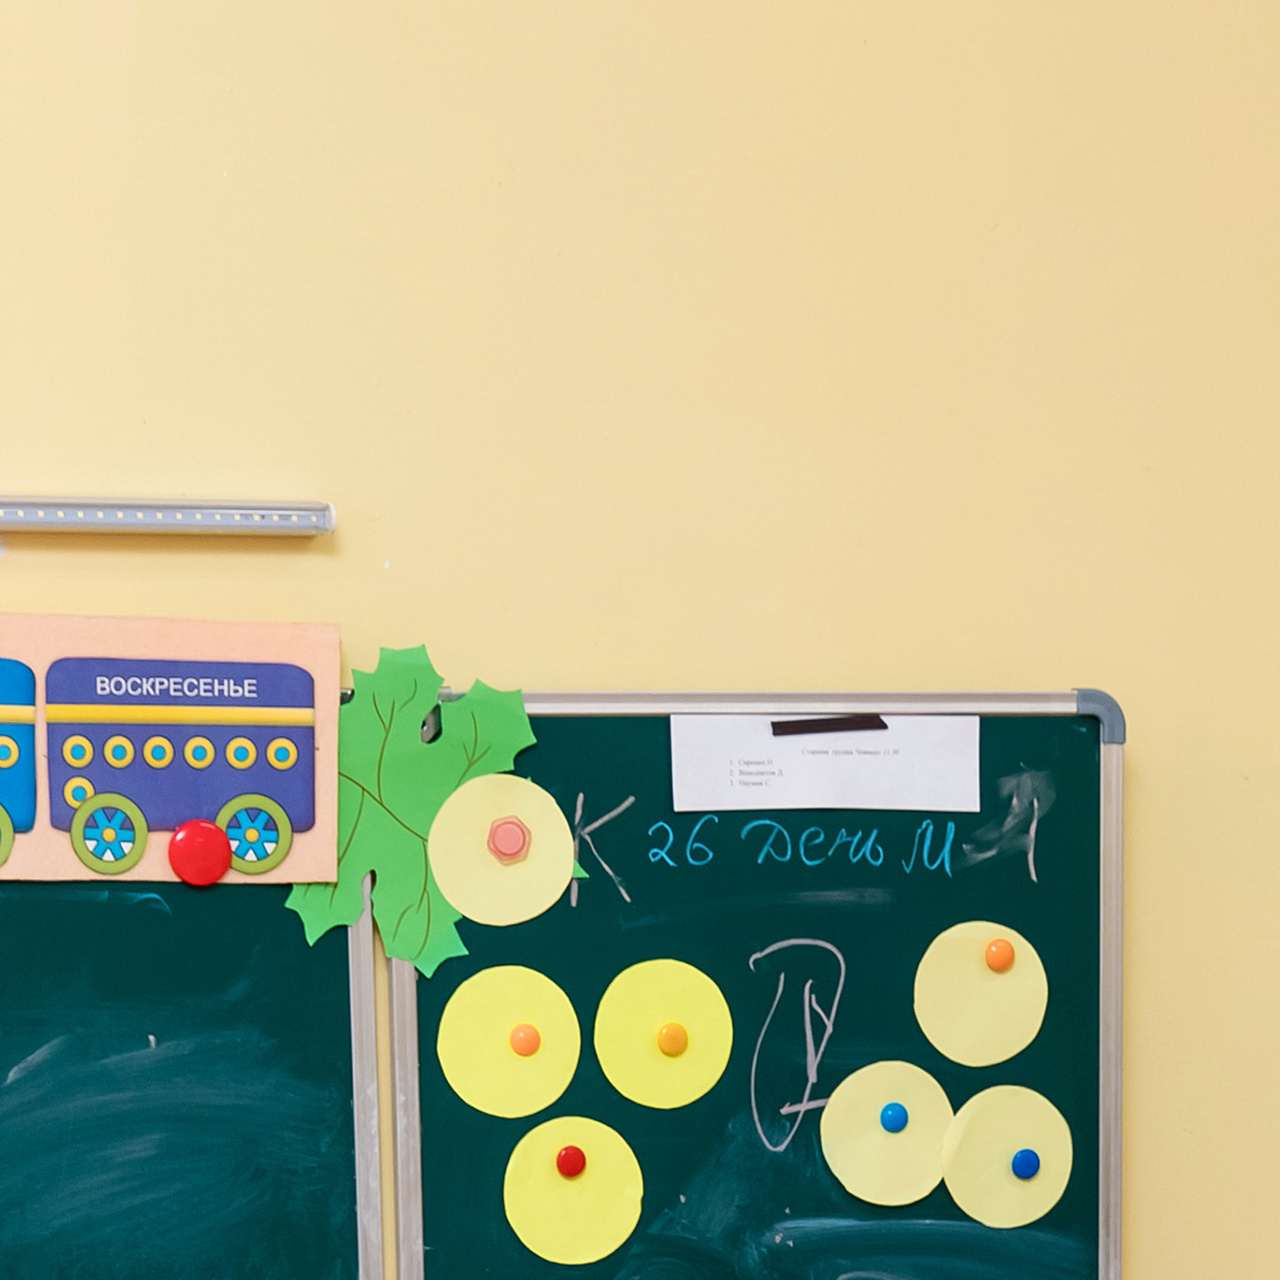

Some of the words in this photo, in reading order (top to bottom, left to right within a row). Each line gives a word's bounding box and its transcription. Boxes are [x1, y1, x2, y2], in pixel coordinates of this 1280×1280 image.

[95, 675, 258, 698] ВОСКРЕСЕНЬЕ
[648, 814, 719, 868] 26
[740, 819, 884, 867] День
